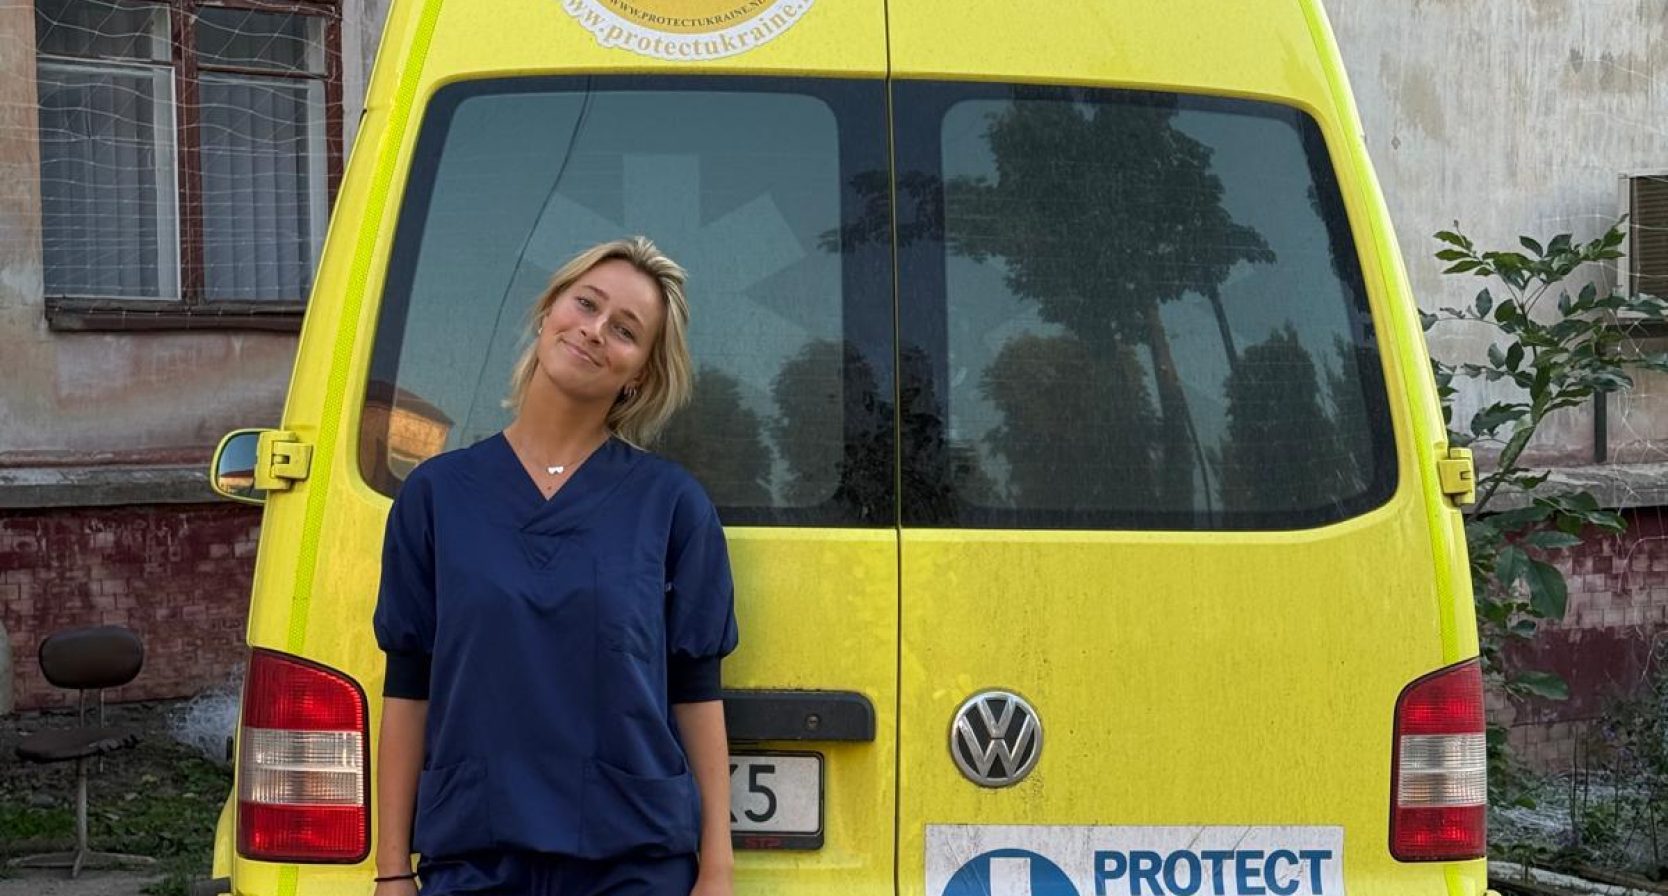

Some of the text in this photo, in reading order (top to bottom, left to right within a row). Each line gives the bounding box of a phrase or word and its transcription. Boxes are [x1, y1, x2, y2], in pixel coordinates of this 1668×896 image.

[567, 0, 808, 56] ww.protectukraine.
[957, 696, 1036, 780] VW
[1094, 849, 1332, 896] PROTECT
